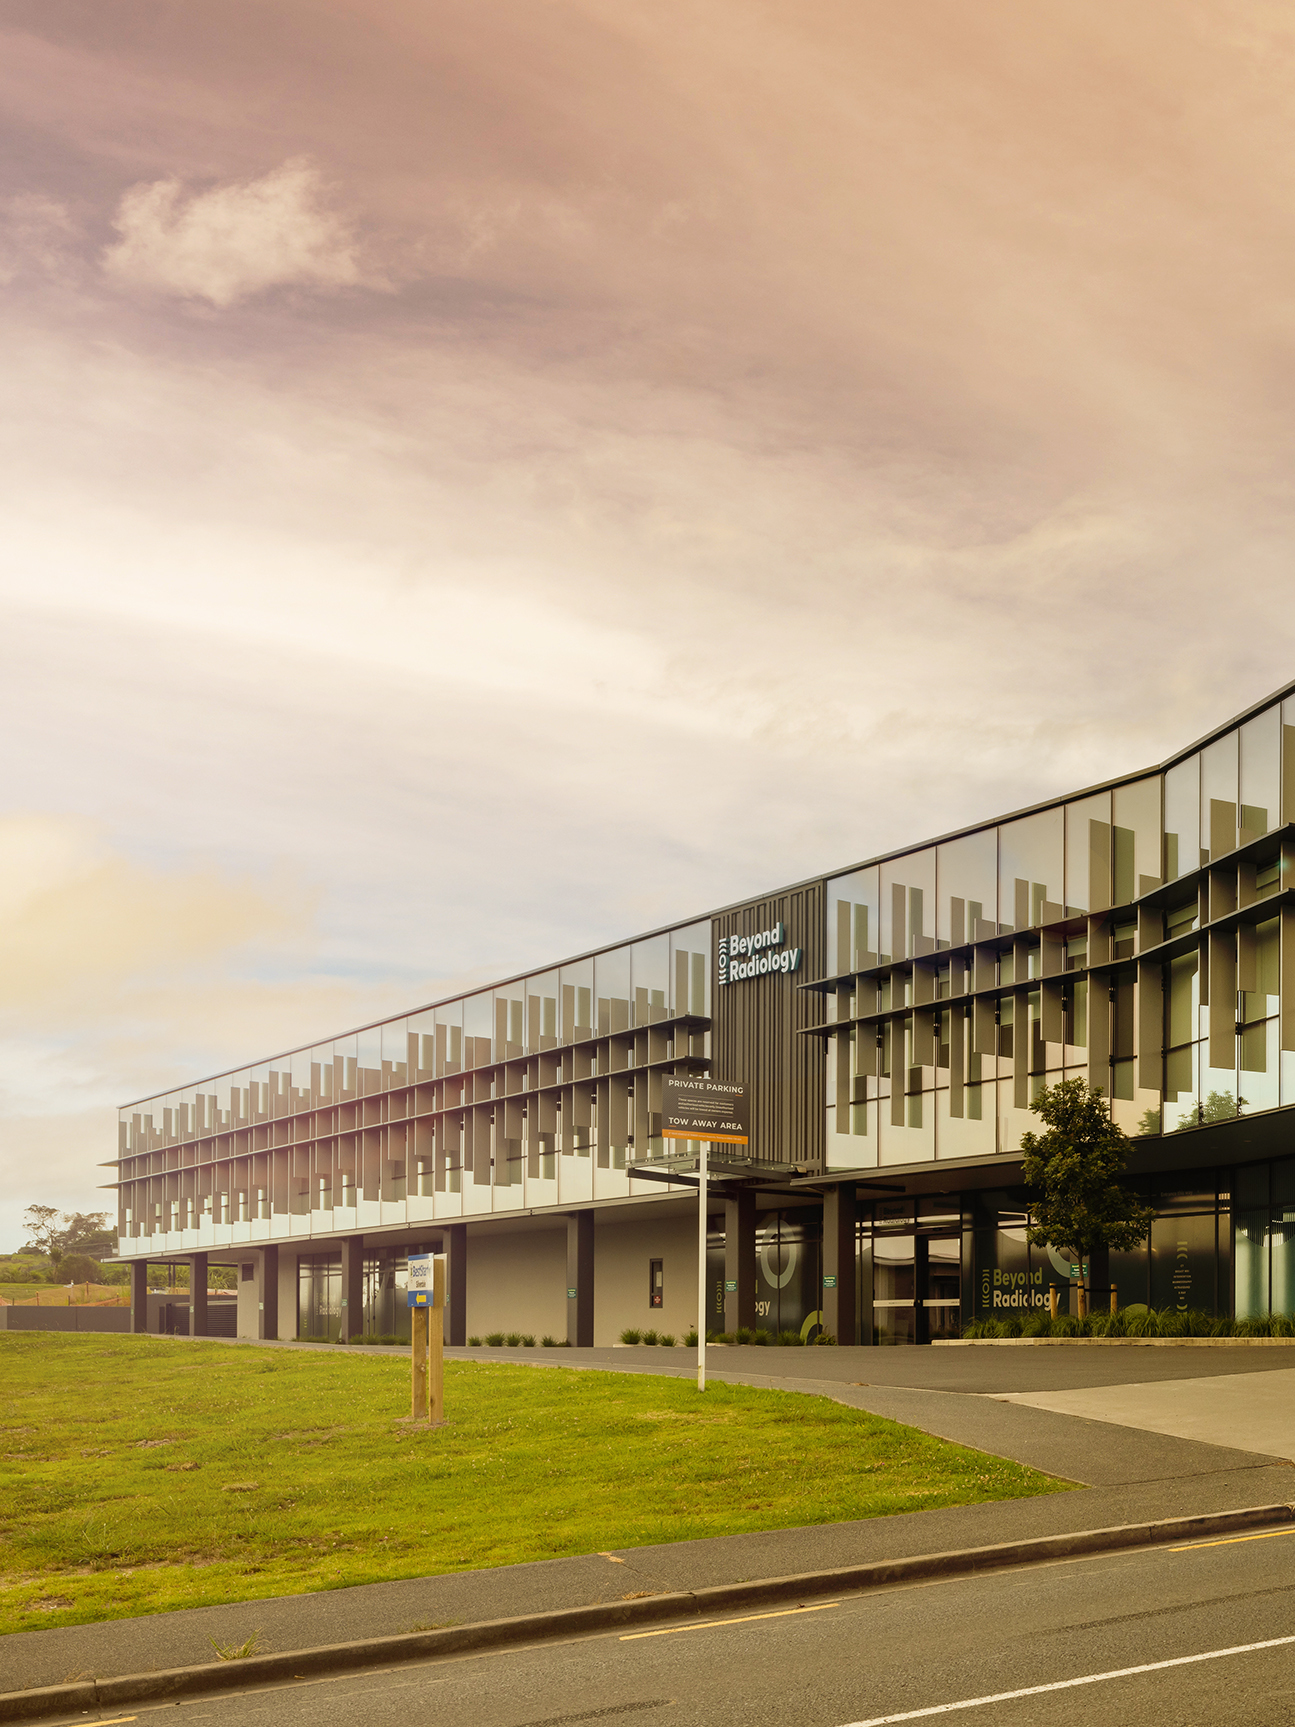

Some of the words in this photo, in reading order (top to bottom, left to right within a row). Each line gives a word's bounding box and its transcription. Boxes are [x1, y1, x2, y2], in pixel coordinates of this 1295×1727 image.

[729, 922, 783, 957] Beyond
[729, 948, 801, 982] Radiology
[668, 1079, 704, 1090] PRIVATE
[706, 1083, 744, 1094] PARKING
[668, 1117, 689, 1125] TOW
[692, 1119, 718, 1128] AWAY
[720, 1122, 743, 1131] AREA
[993, 1266, 1042, 1290] Beyond
